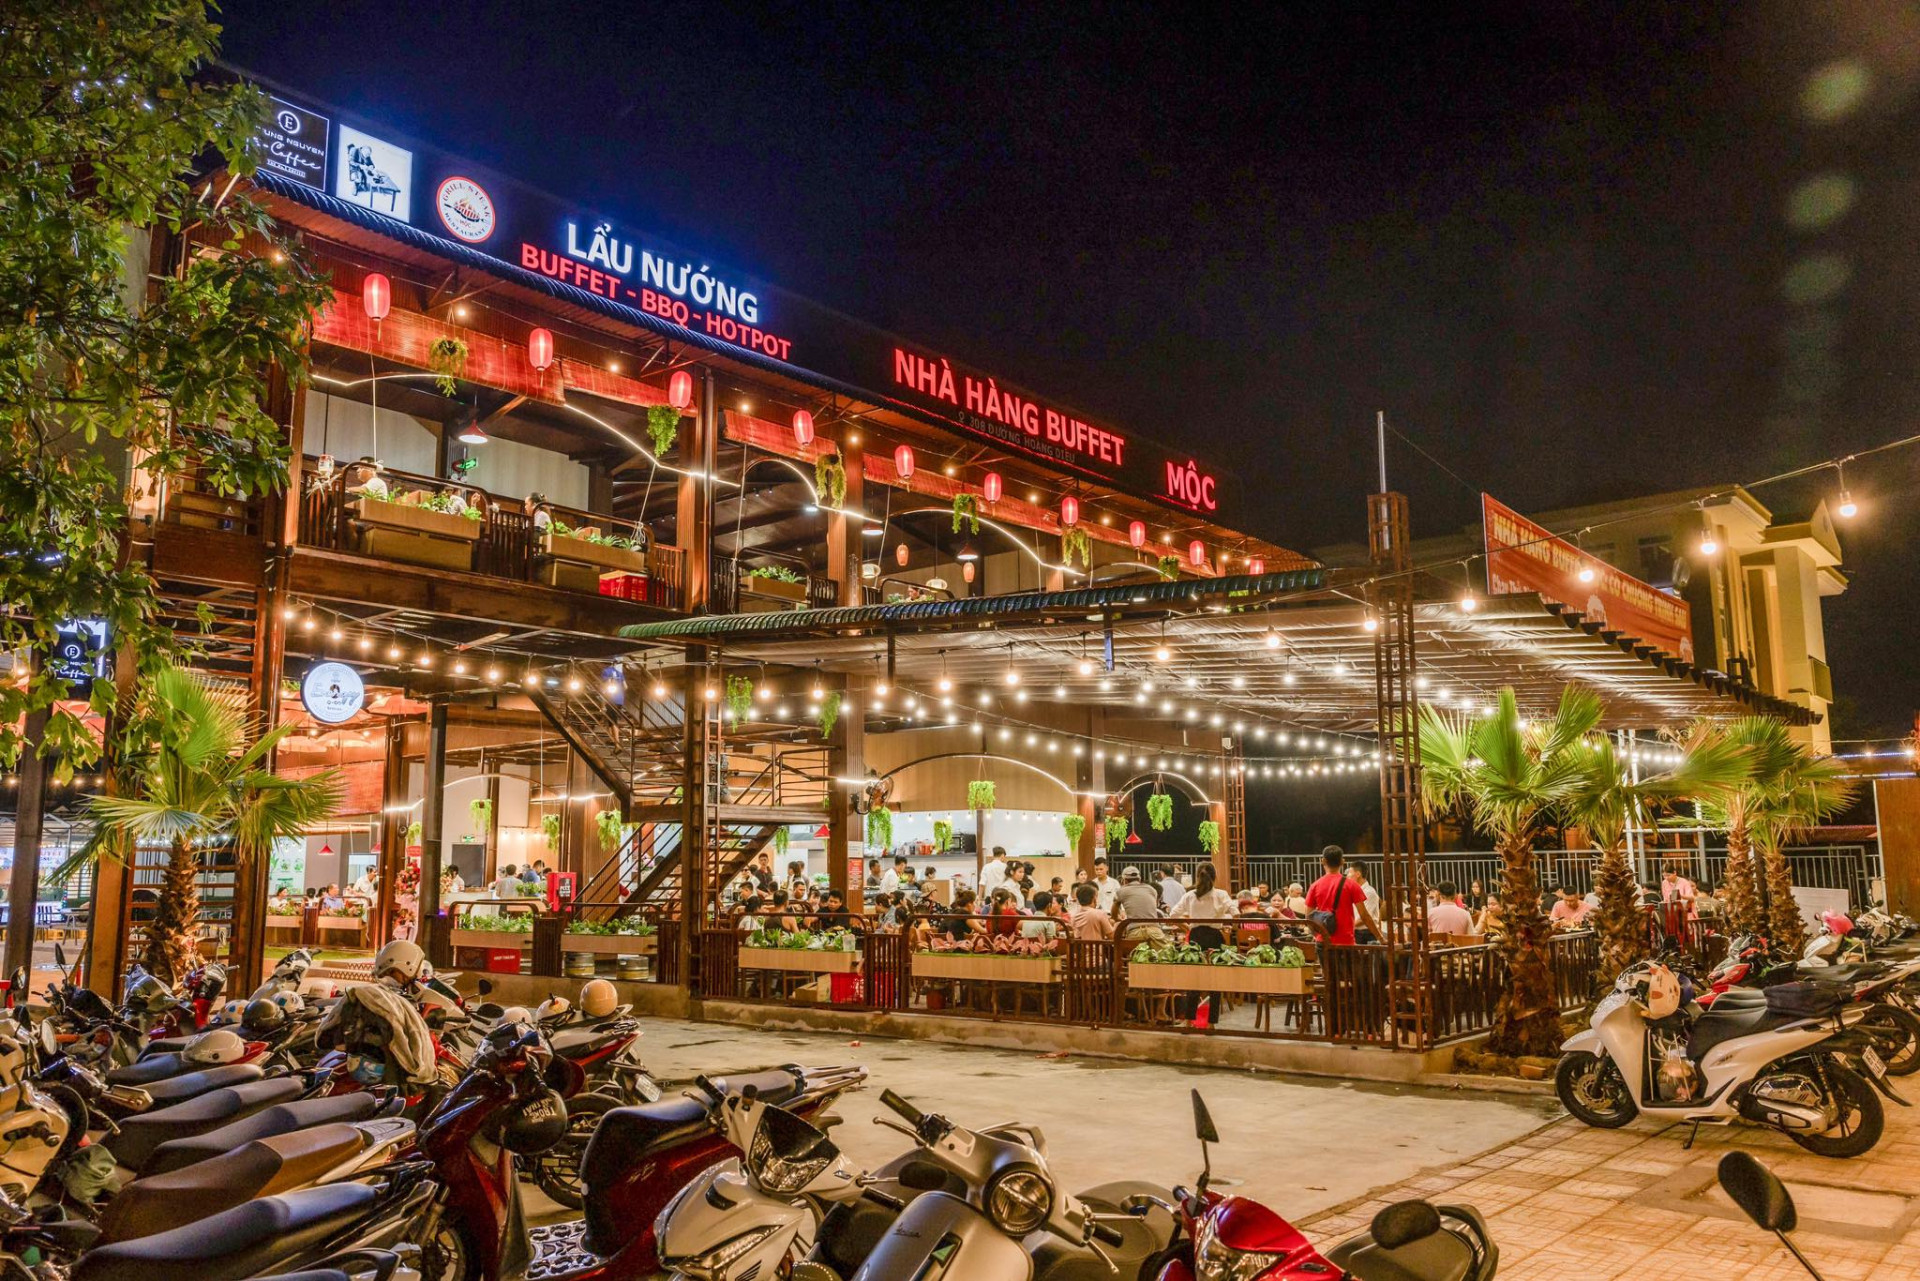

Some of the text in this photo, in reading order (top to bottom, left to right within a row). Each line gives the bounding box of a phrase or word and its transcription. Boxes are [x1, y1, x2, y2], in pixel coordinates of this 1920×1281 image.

[284, 115, 294, 130] E
[521, 243, 621, 299] BUFFET
[641, 288, 689, 330] BBQ
[706, 312, 791, 360] HOTPOT
[567, 222, 758, 323] LẨU NƯỚNG
[895, 348, 1124, 466] NHÀ HÀNG BUFFET
[1166, 458, 1217, 511] MỘC
